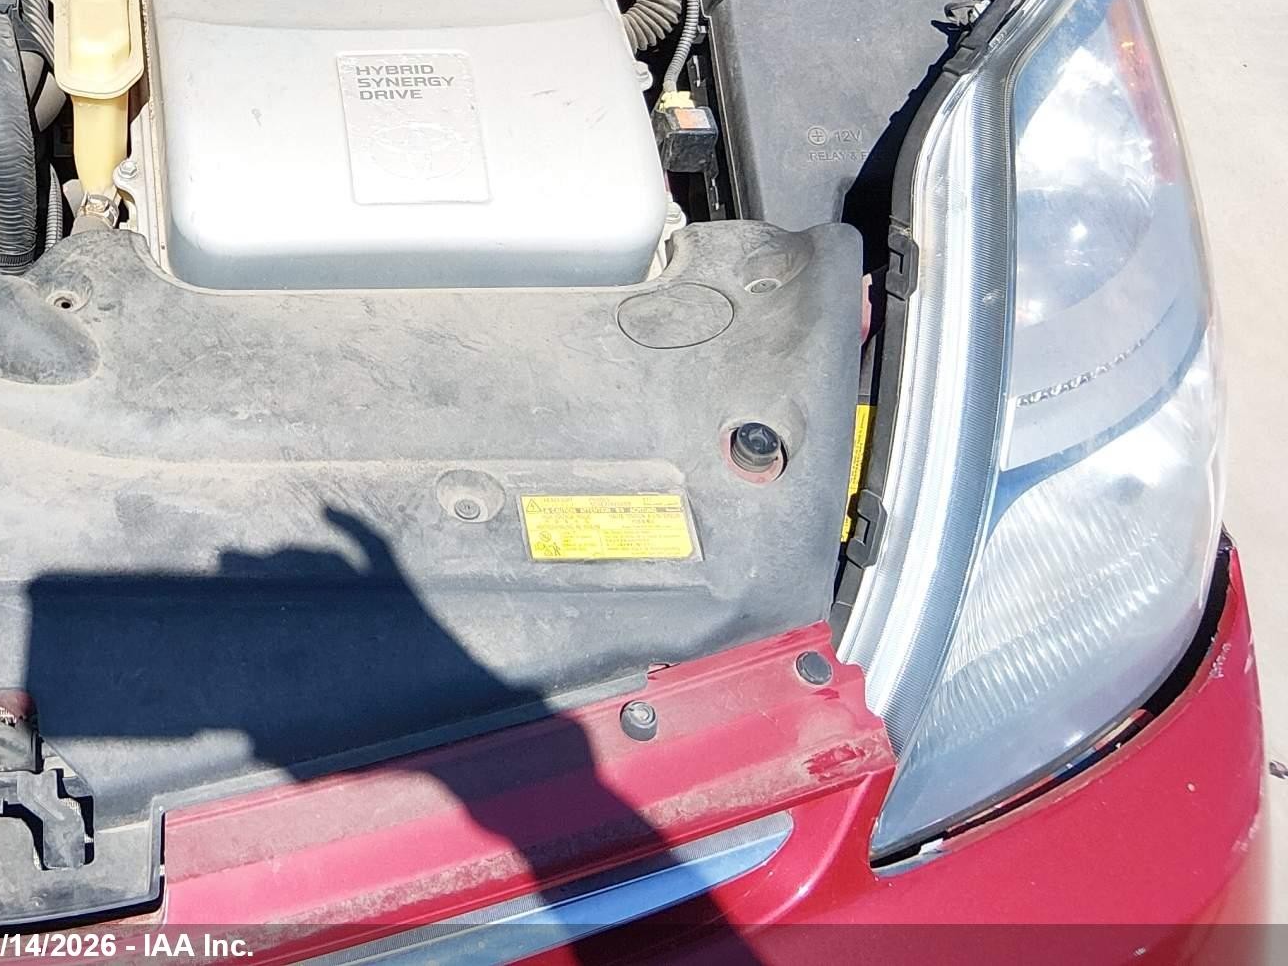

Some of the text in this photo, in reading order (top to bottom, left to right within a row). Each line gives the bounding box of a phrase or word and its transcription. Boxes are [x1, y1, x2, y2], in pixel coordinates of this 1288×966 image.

[355, 64, 434, 76] HYBRID
[357, 76, 455, 88] SYNERGY
[359, 89, 423, 100] DRIVE
[834, 129, 861, 142] 12V
